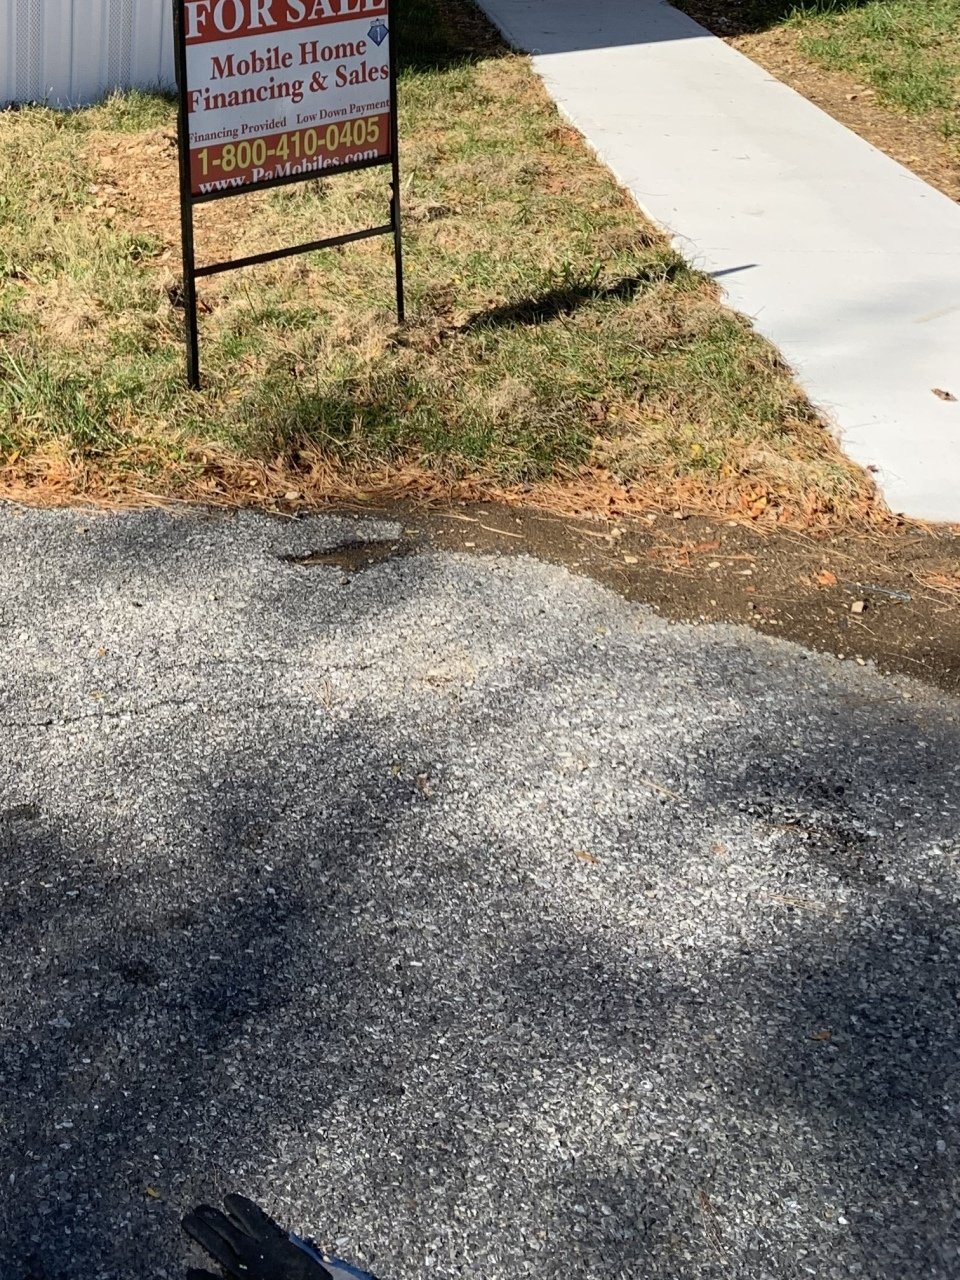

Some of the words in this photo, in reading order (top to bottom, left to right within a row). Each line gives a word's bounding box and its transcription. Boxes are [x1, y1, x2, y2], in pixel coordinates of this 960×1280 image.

[210, 46, 293, 80] Mobile
[298, 40, 367, 66] Home
[187, 76, 304, 114] Financing
[309, 70, 328, 93] &
[335, 60, 389, 88] Sales
[241, 116, 287, 134] Provided
[296, 112, 318, 125] Low
[319, 106, 348, 120] Down
[198, 116, 380, 176] 1-800-410-0405
[198, 147, 379, 195] www.PaMobiles.com
